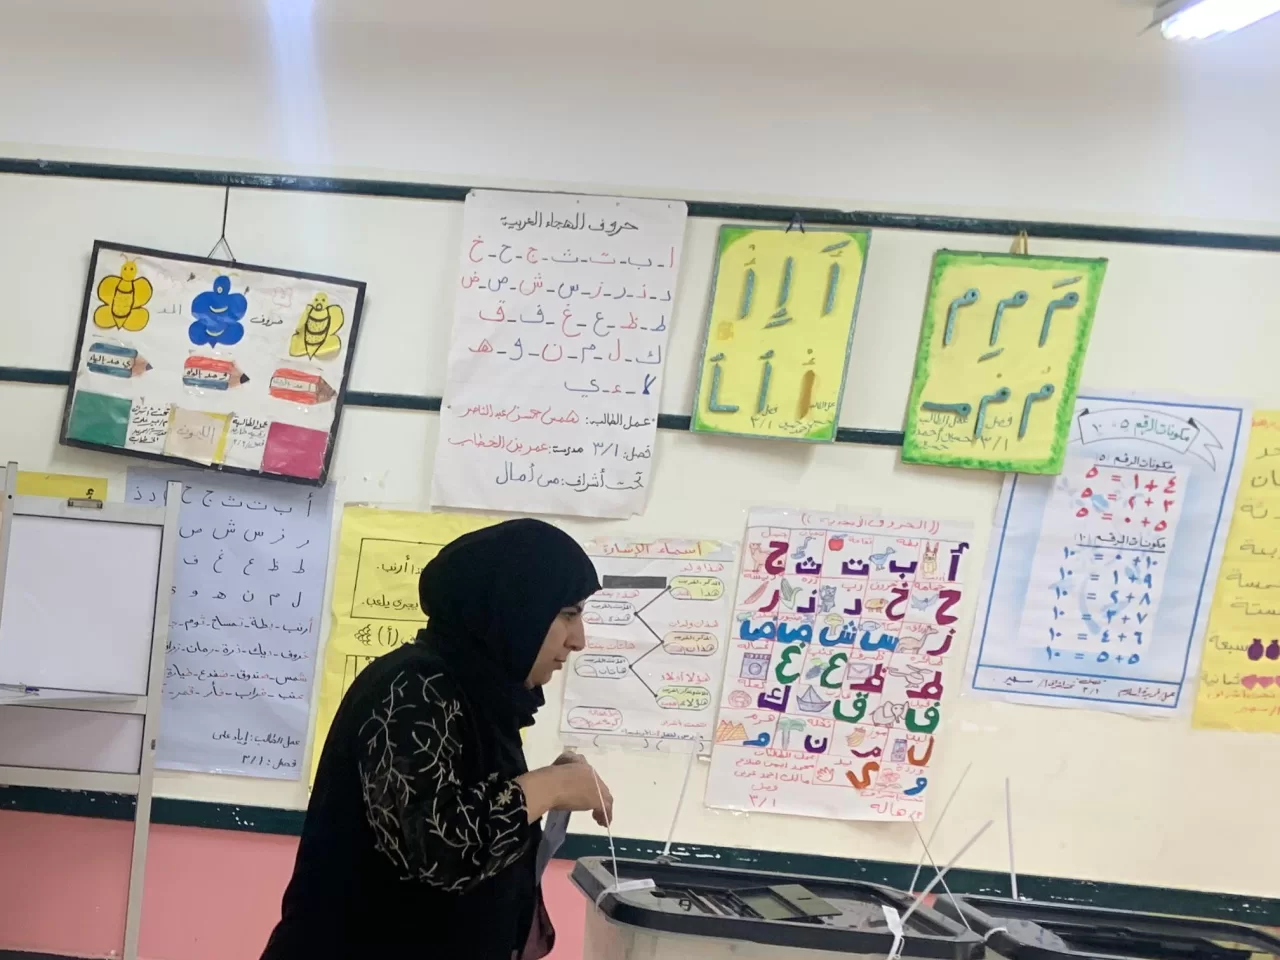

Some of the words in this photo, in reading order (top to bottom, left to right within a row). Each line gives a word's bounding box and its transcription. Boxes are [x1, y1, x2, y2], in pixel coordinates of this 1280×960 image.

[546, 212, 585, 230] الهجاء
[588, 220, 639, 236] حروف
[1156, 423, 1190, 441] مكونات
[1139, 458, 1173, 471] مكونات
[181, 485, 192, 504] ح
[202, 489, 214, 507] ج
[221, 495, 243, 507] ث
[246, 500, 267, 510] ت
[273, 505, 292, 516] ب
[306, 491, 313, 517] أ
[1131, 534, 1166, 549] مكونات
[764, 540, 789, 575] ج
[795, 556, 821, 575] ث
[947, 541, 970, 582] أ
[841, 558, 870, 576] ت
[889, 559, 918, 580] ب
[758, 589, 780, 613] ر
[796, 588, 818, 614] ذ
[843, 598, 862, 616] د
[885, 581, 909, 622] خ
[935, 588, 962, 625] ح
